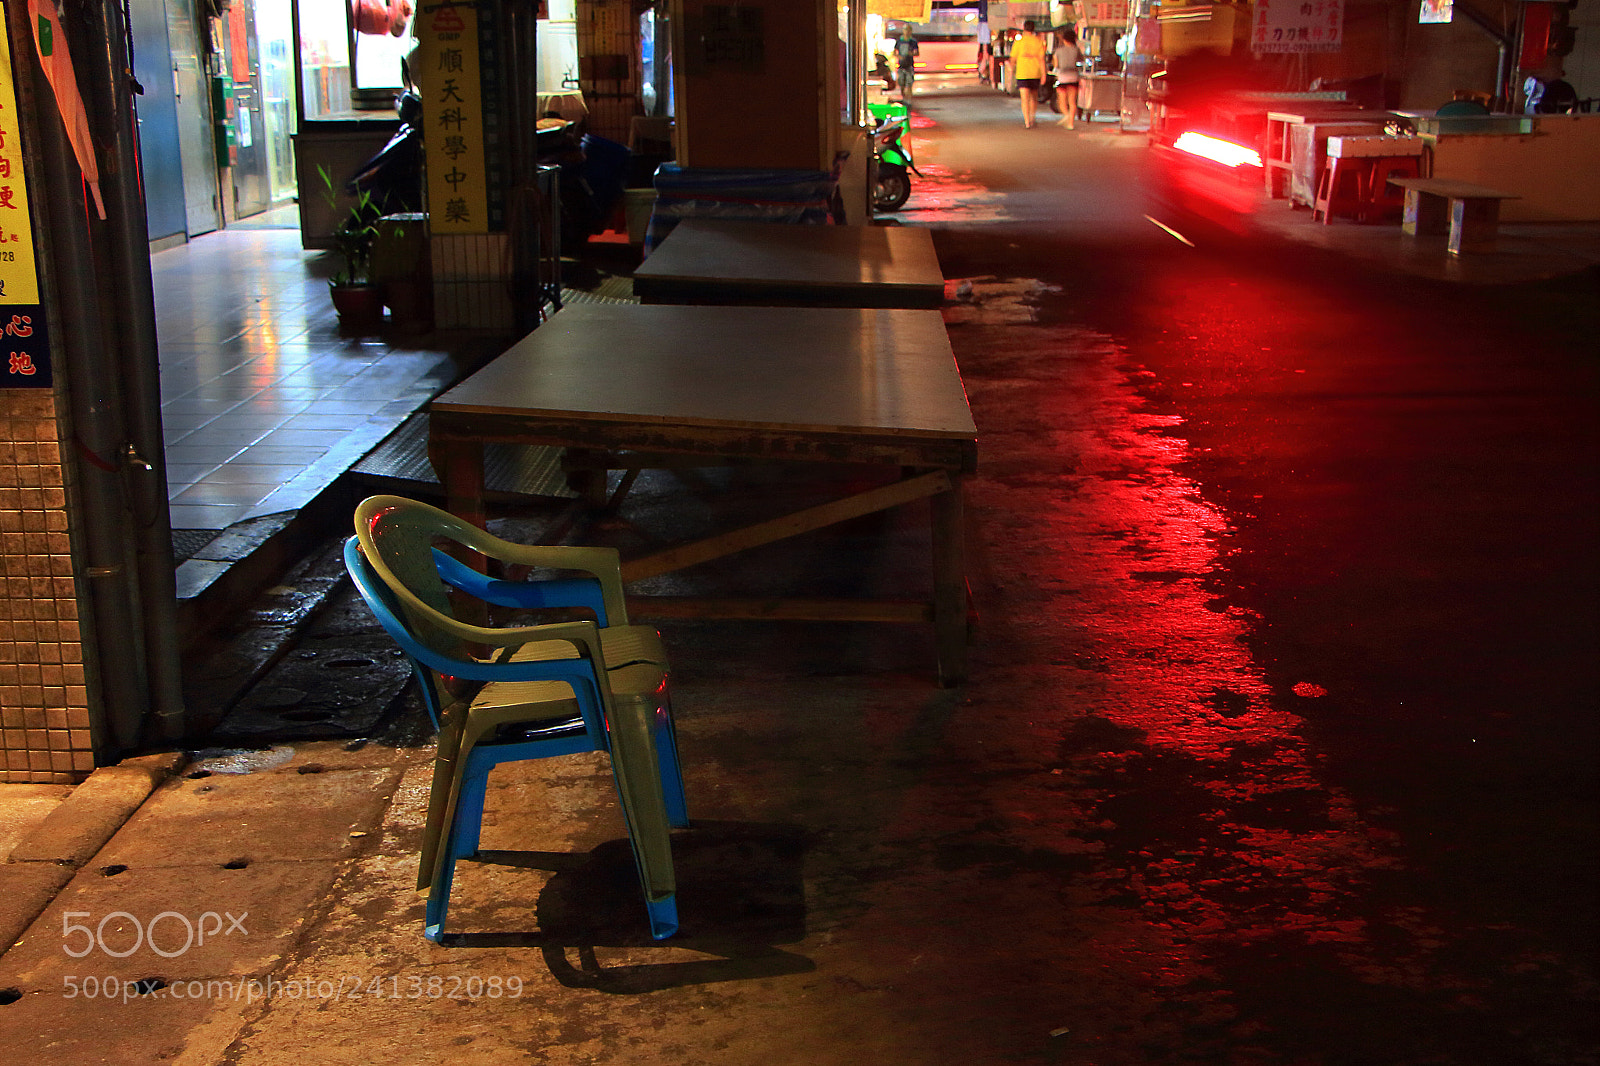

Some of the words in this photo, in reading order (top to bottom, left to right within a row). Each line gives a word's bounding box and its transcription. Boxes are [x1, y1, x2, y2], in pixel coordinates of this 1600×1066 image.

[437, 47, 470, 224] 順天科學中藥
[0, 314, 34, 340] 心
